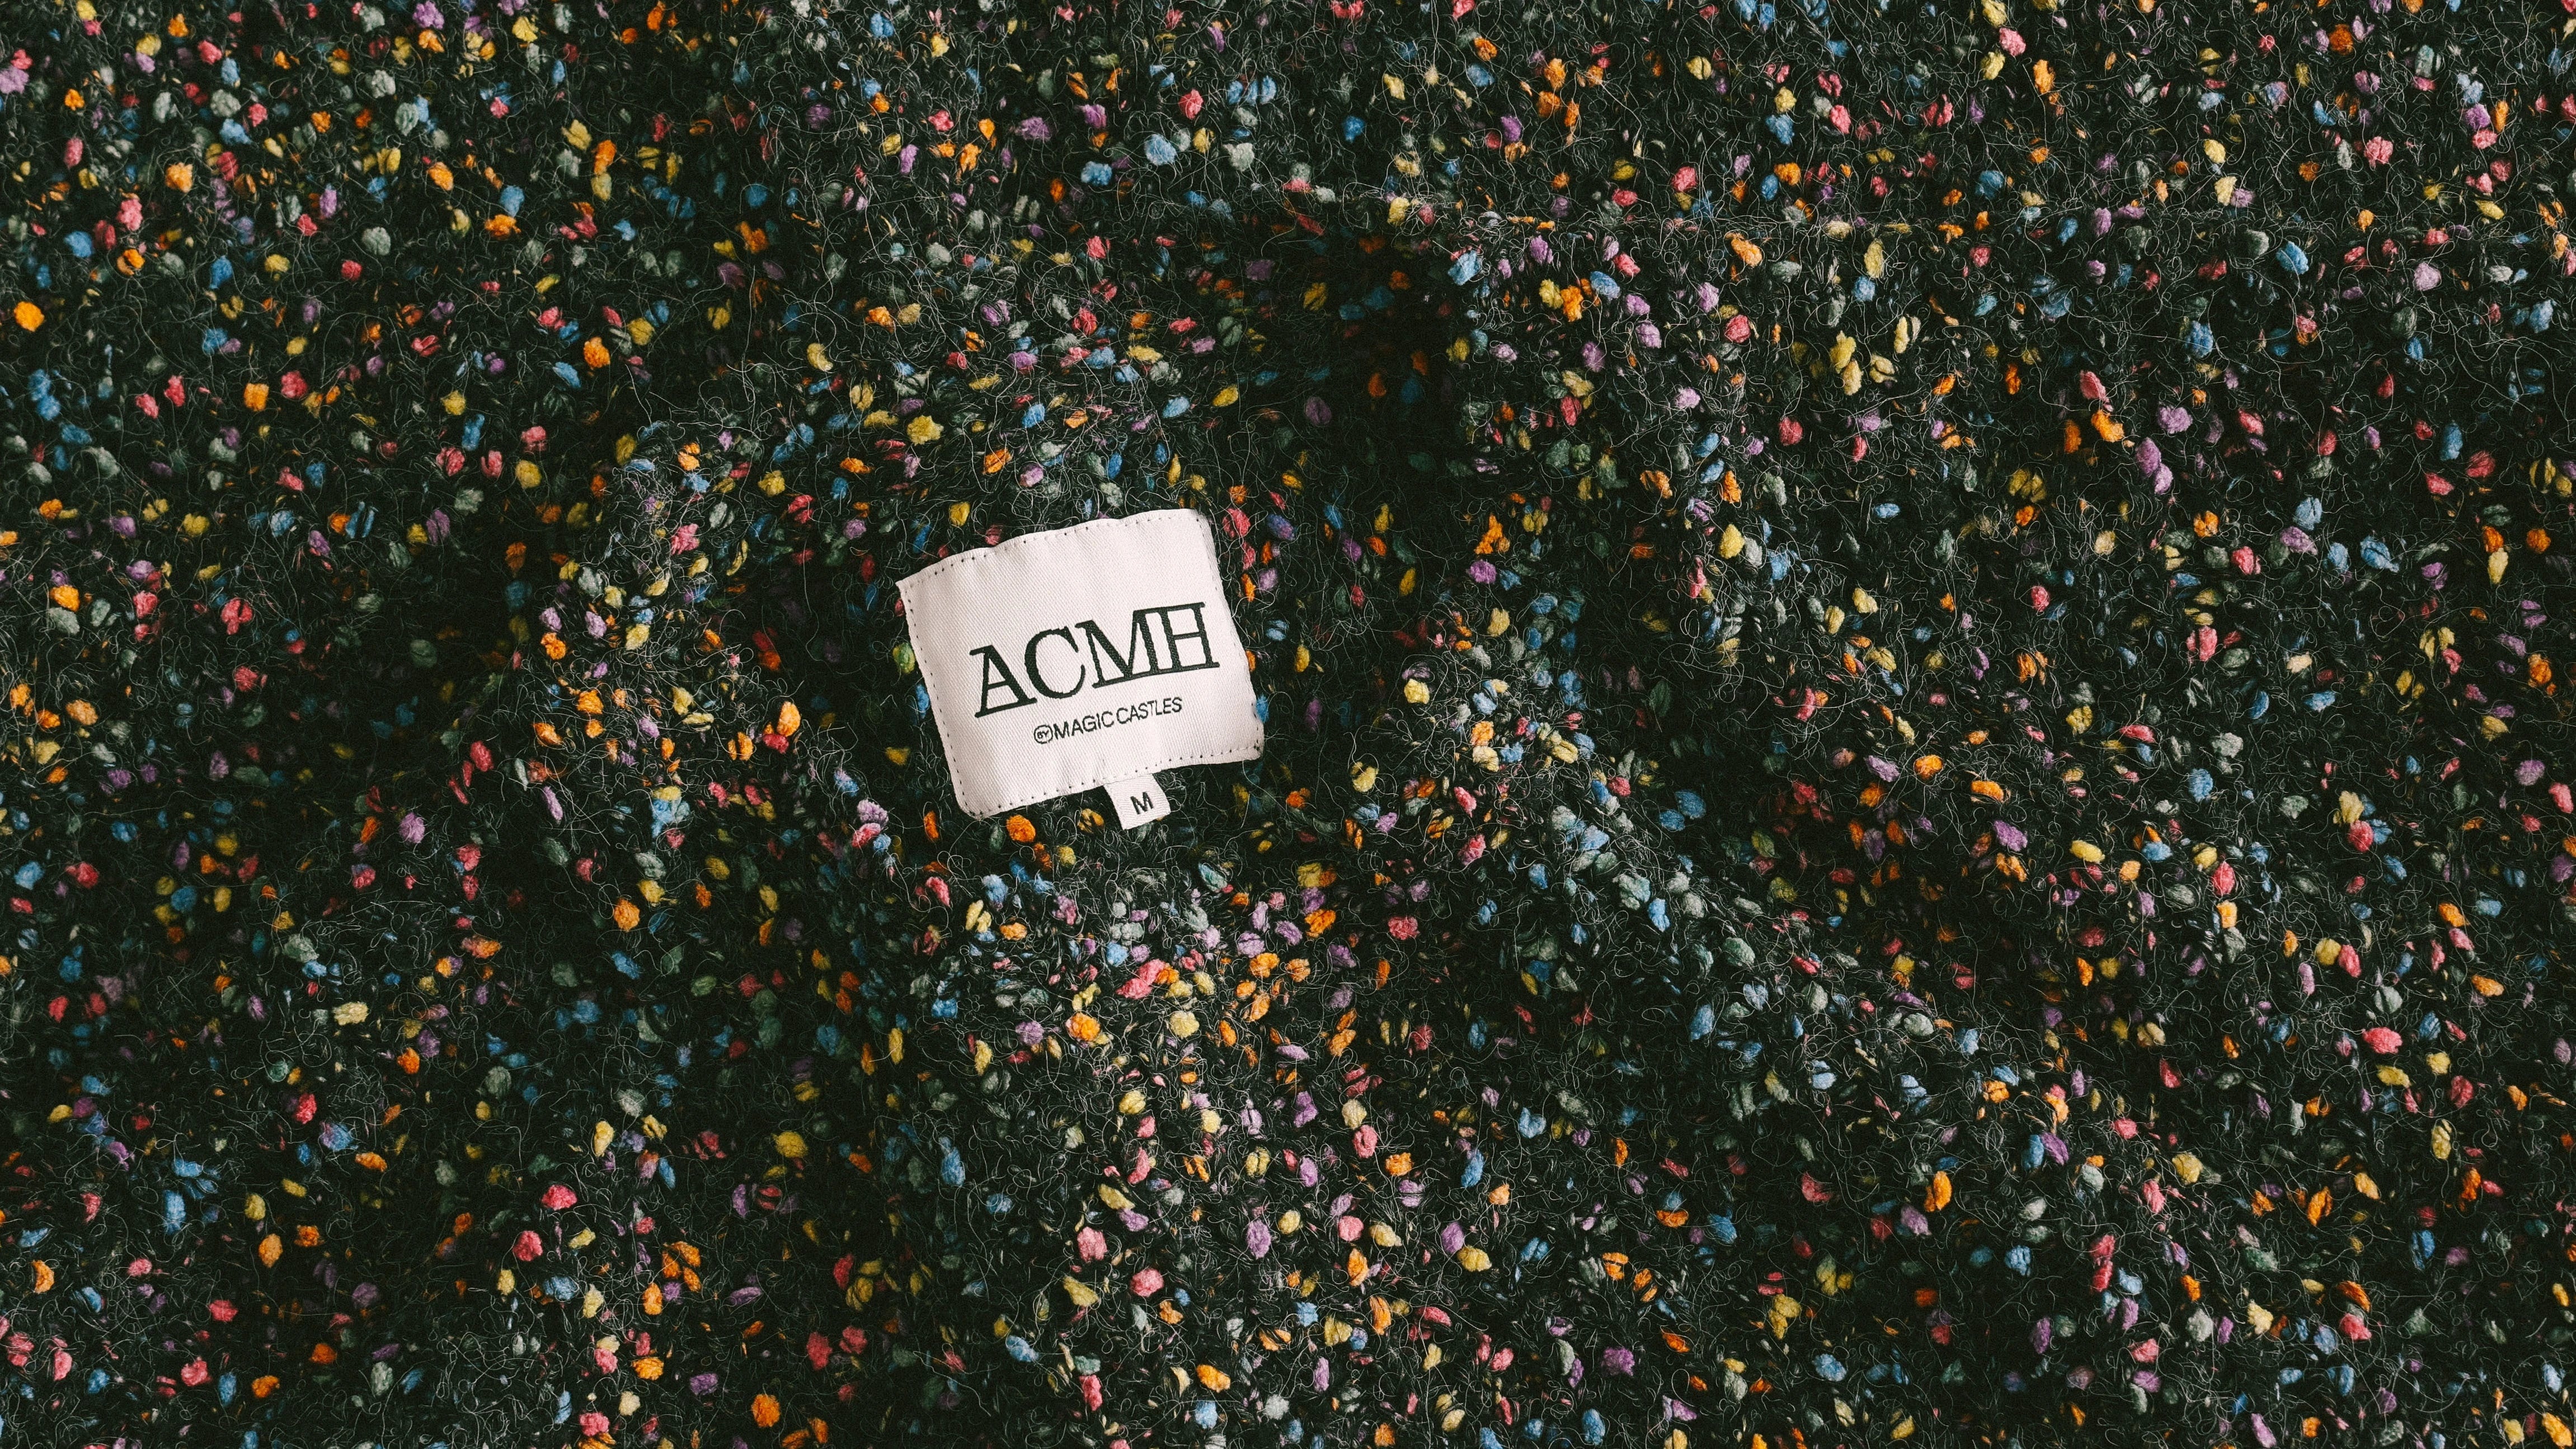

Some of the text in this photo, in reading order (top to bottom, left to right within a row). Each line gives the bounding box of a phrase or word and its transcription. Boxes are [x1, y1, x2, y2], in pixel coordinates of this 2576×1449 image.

[970, 602, 1220, 718] ACMH
[1054, 711, 1115, 740] MAGIC
[1116, 697, 1182, 724] CASTLES
[1130, 792, 1154, 815] M
